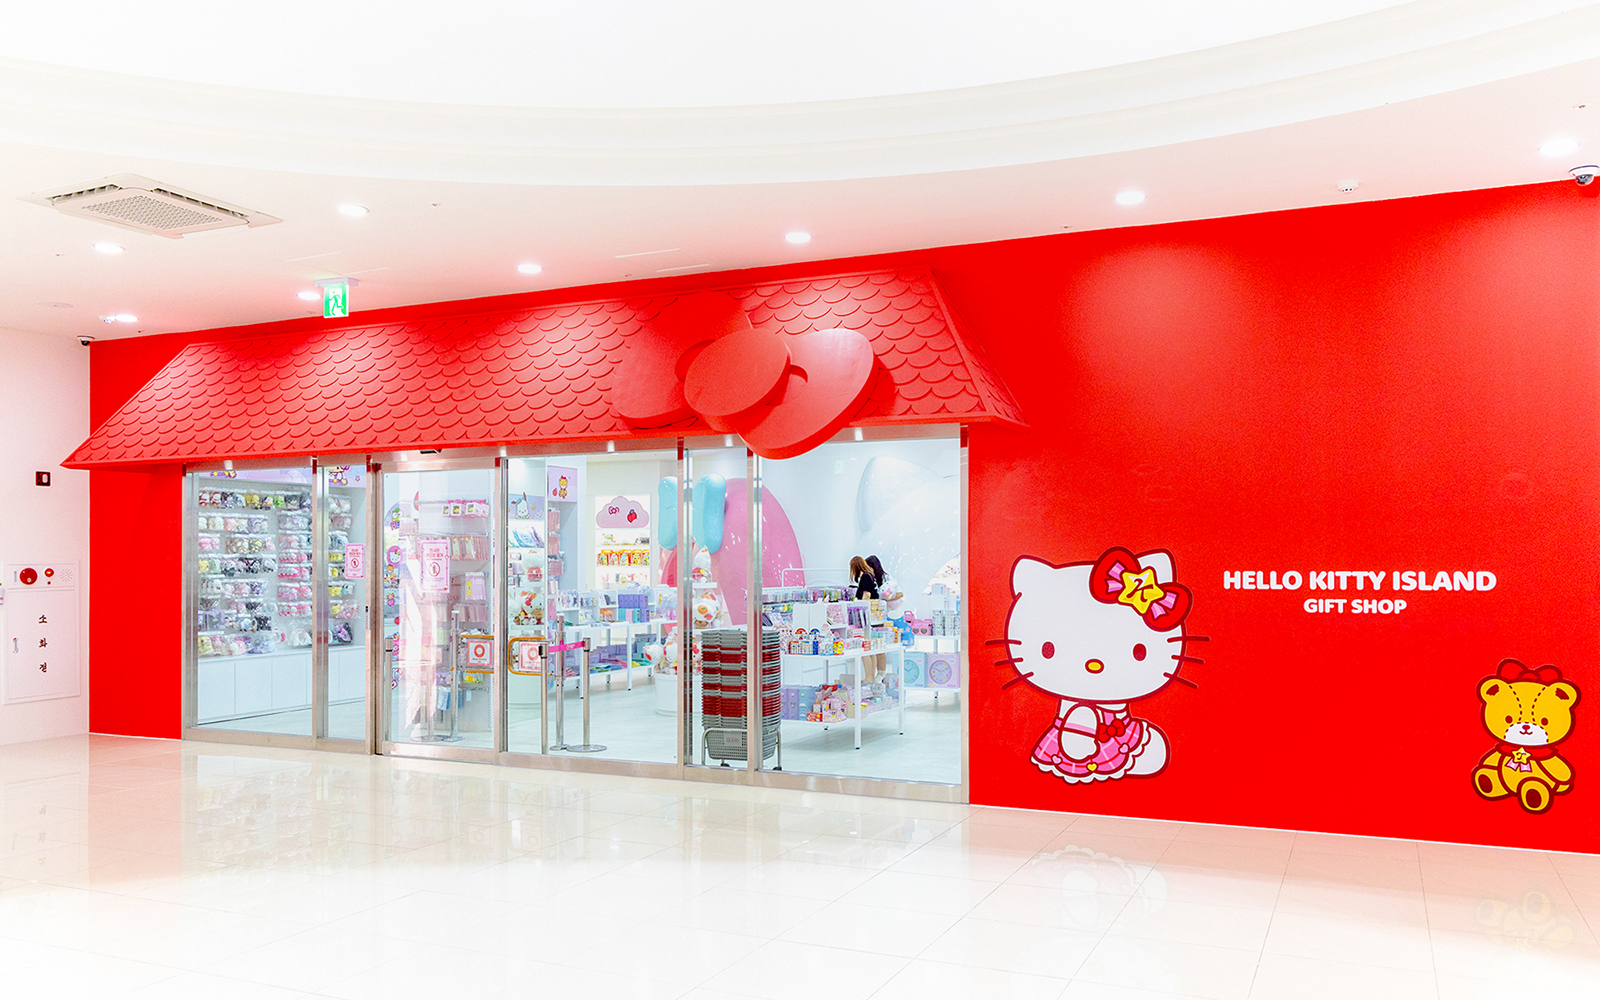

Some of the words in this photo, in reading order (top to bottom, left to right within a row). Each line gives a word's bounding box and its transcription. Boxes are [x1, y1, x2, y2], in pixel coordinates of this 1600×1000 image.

[1223, 570, 1303, 590] HELLO
[1309, 570, 1387, 591] KITTY
[1392, 570, 1497, 592] ISLAND
[1303, 598, 1348, 614] GIFT
[1350, 598, 1407, 615] SHOP
